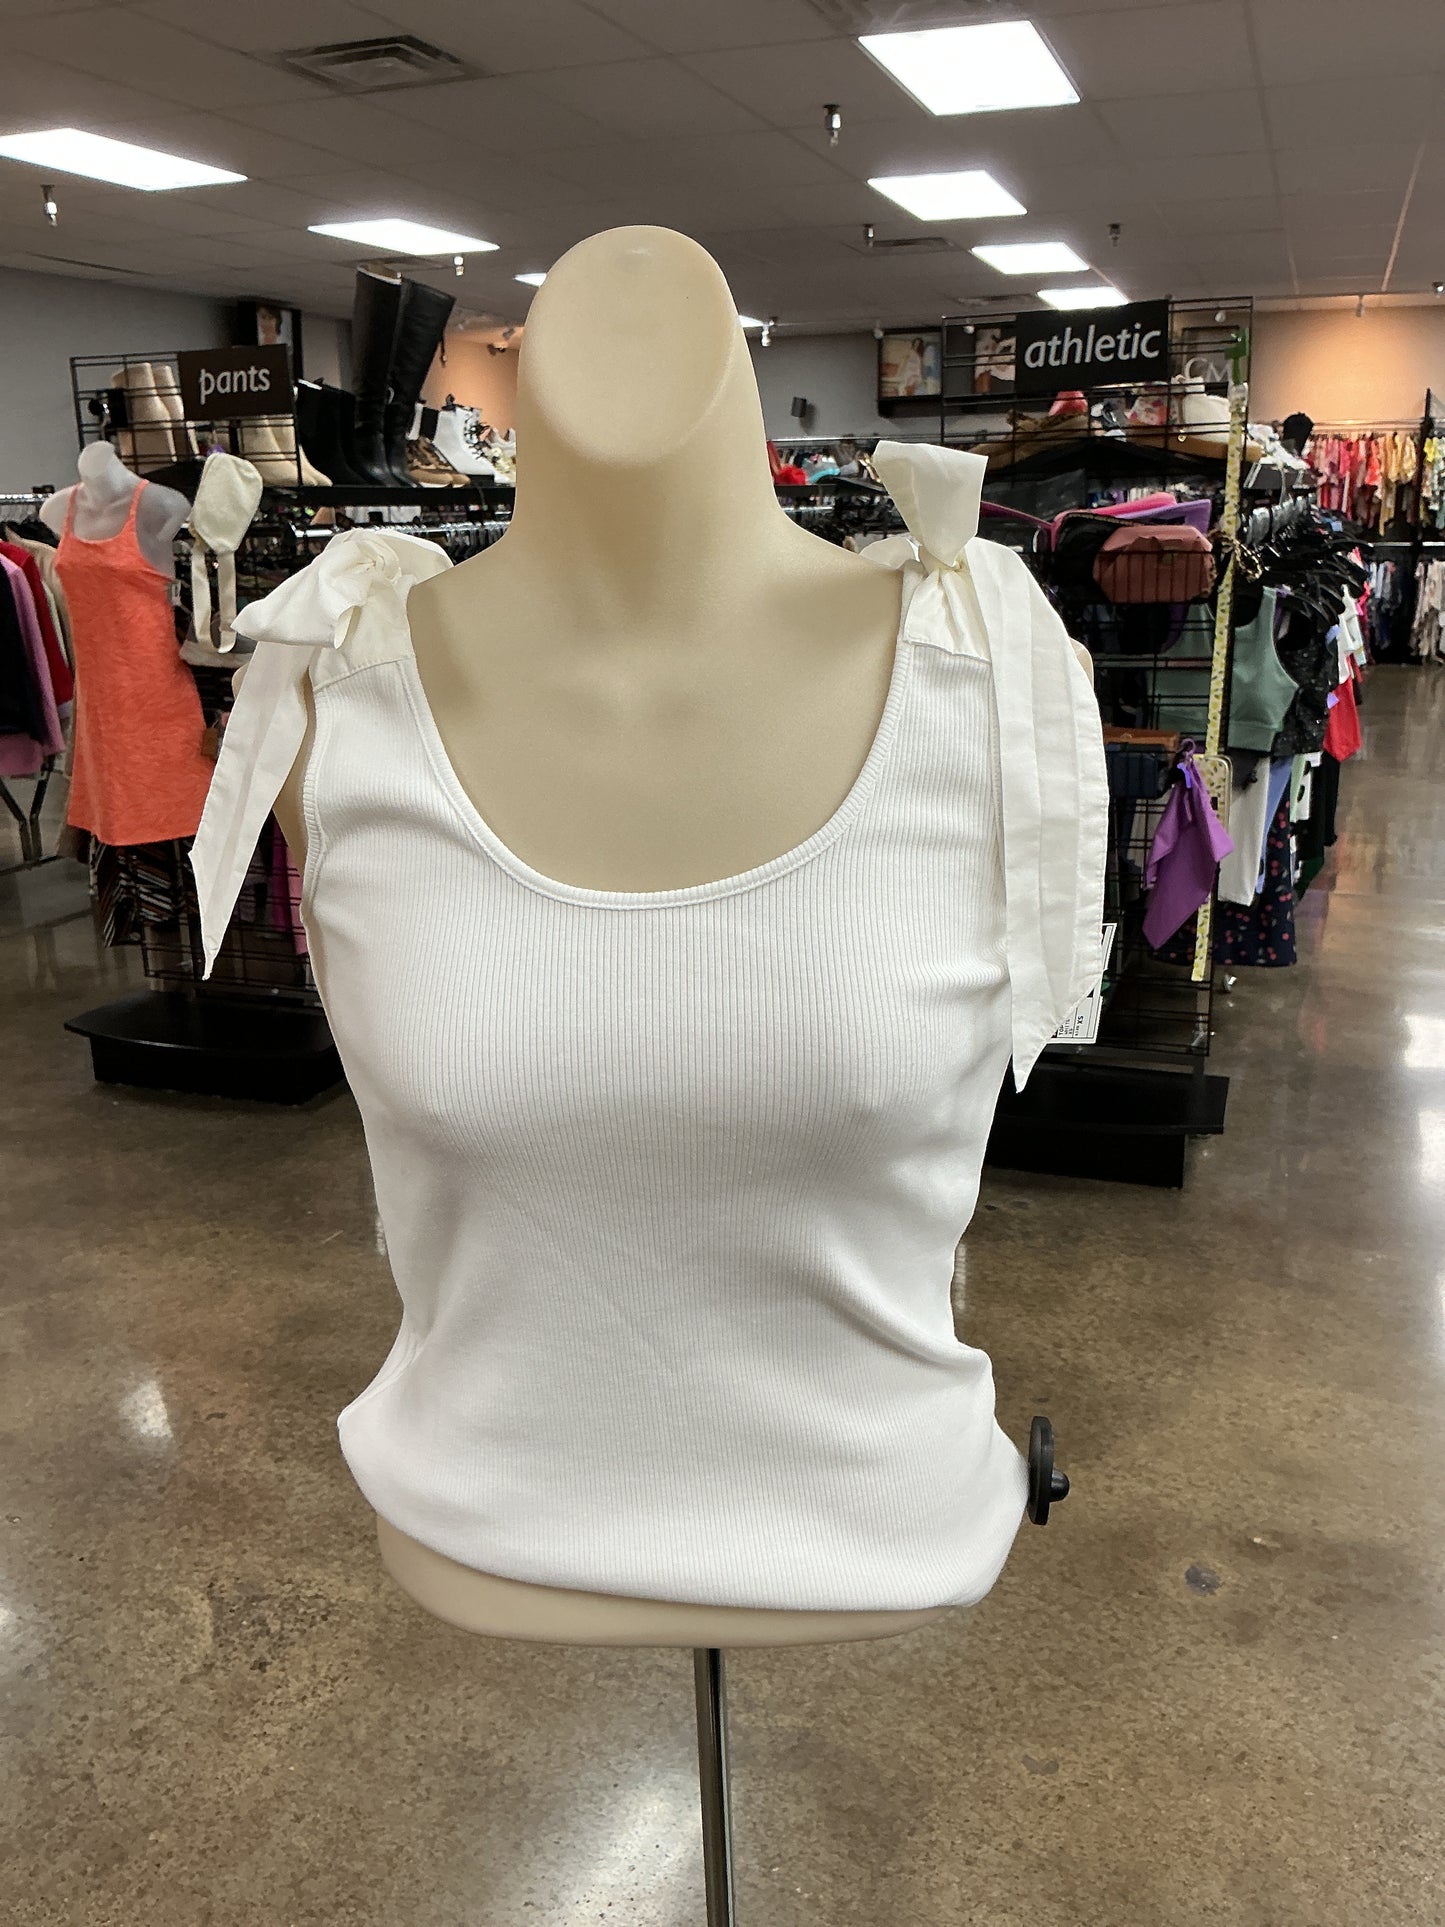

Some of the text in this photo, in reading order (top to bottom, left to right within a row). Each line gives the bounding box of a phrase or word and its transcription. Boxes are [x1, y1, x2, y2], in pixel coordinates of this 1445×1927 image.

[1024, 322, 1161, 368] athletic
[199, 365, 271, 405] pants
[1077, 1016, 1083, 1024] XS
